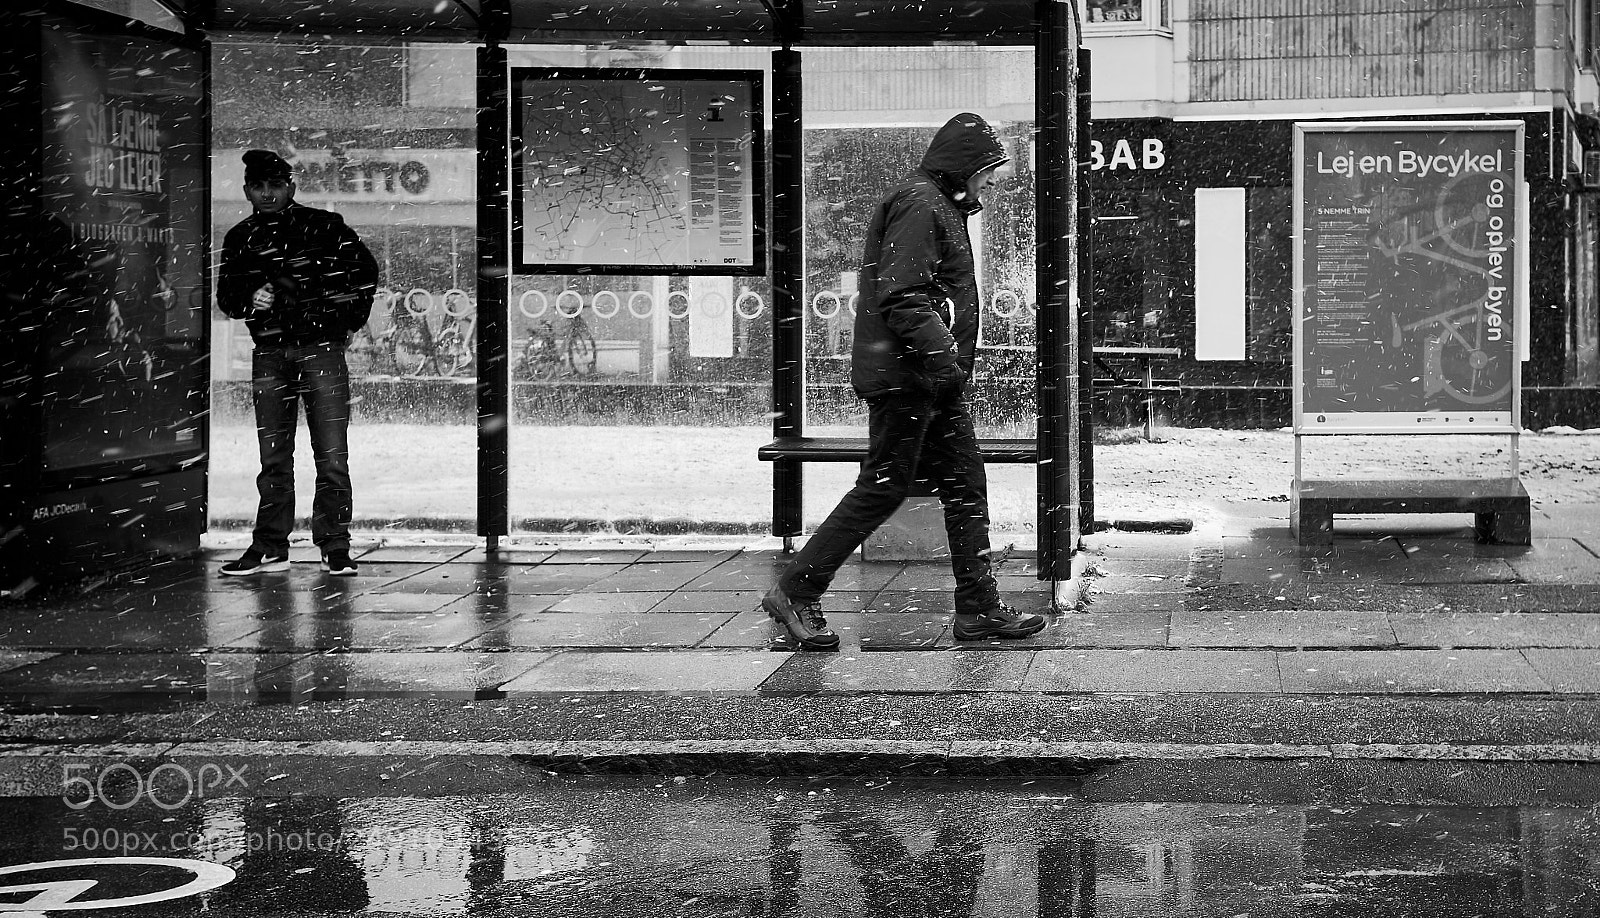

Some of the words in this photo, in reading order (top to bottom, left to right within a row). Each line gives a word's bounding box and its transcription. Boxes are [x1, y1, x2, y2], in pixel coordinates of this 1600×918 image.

[112, 107, 161, 152] LÆNGE
[85, 146, 114, 189] JEG
[119, 150, 162, 193] LEVER
[1091, 139, 1165, 170] BAB
[1317, 151, 1354, 177] Lej
[1359, 154, 1392, 173] en
[1399, 149, 1502, 177] Bycykel
[1486, 179, 1504, 208] og
[1324, 207, 1351, 215] NEMME
[1486, 216, 1507, 279] oplev
[1484, 287, 1506, 341] byen
[32, 507, 49, 520] AFA
